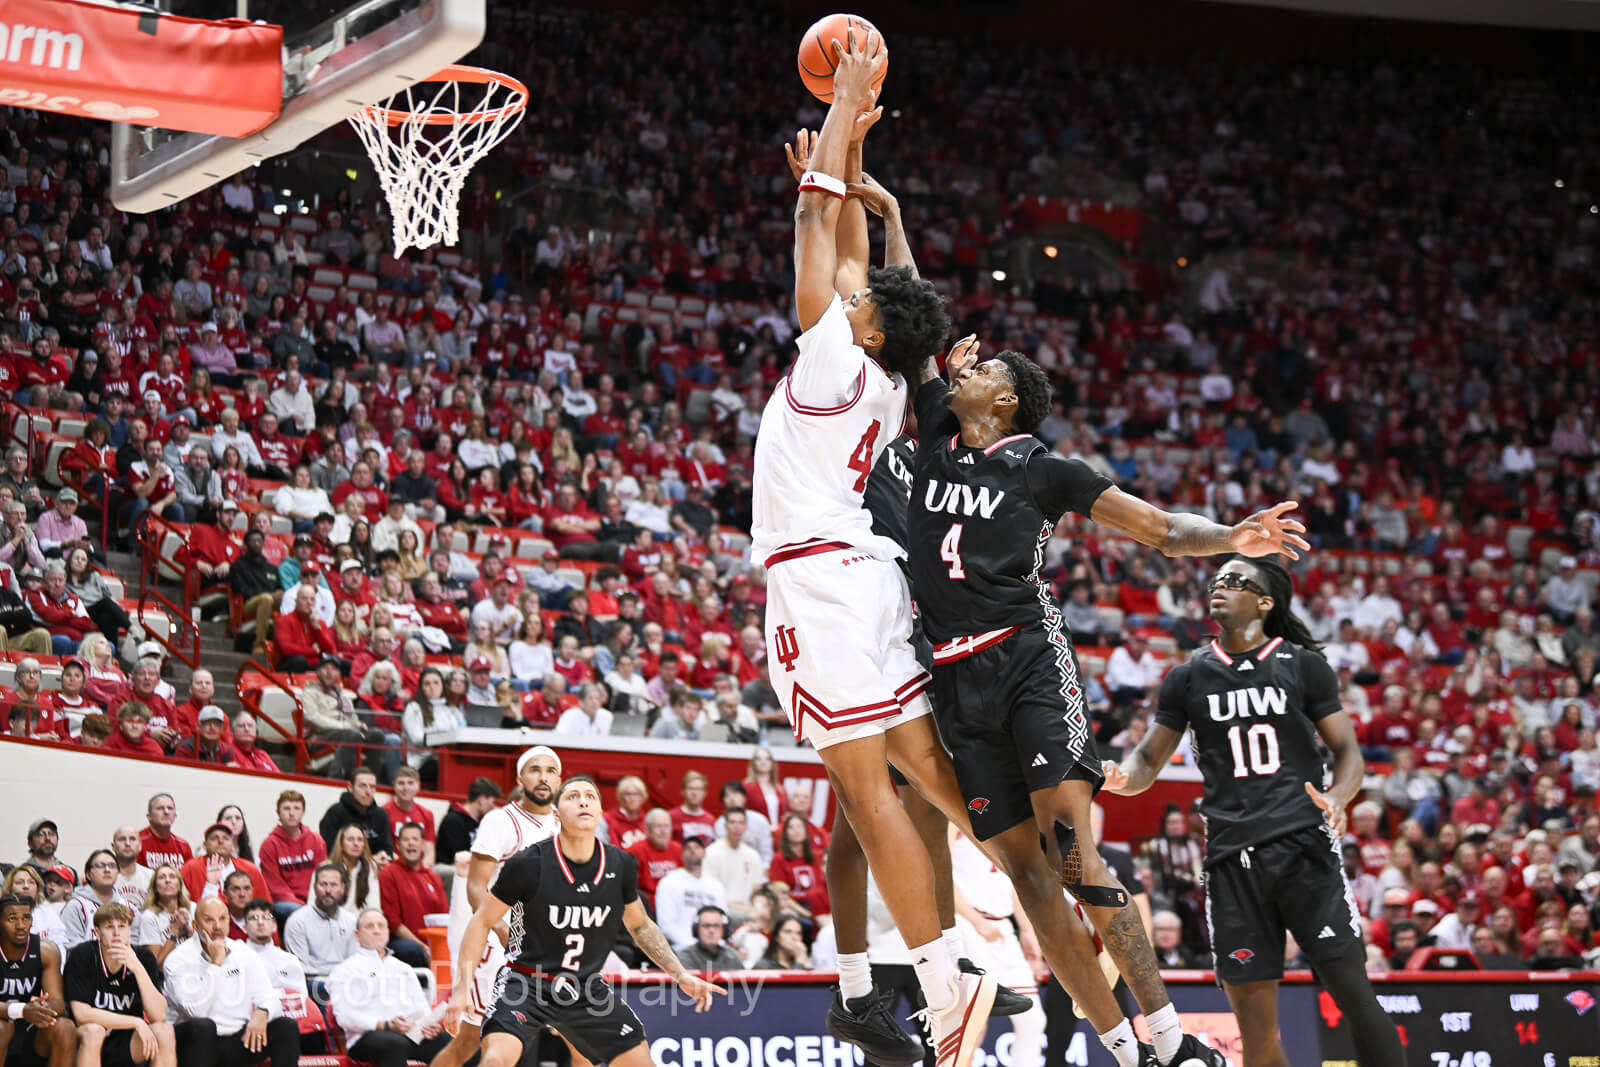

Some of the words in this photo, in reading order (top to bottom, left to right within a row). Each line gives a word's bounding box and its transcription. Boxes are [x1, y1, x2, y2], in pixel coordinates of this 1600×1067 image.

[0, 22, 84, 71] rm
[847, 418, 881, 493] 4
[924, 479, 1005, 519] UIW
[940, 523, 966, 580] 4
[1206, 686, 1288, 722] UIW
[1227, 723, 1281, 778] 10
[549, 905, 612, 930] UIW
[561, 933, 585, 972] 2
[94, 990, 135, 1011] UIW
[1440, 1012, 1473, 1032] 1ST
[1515, 1021, 1540, 1044] 14
